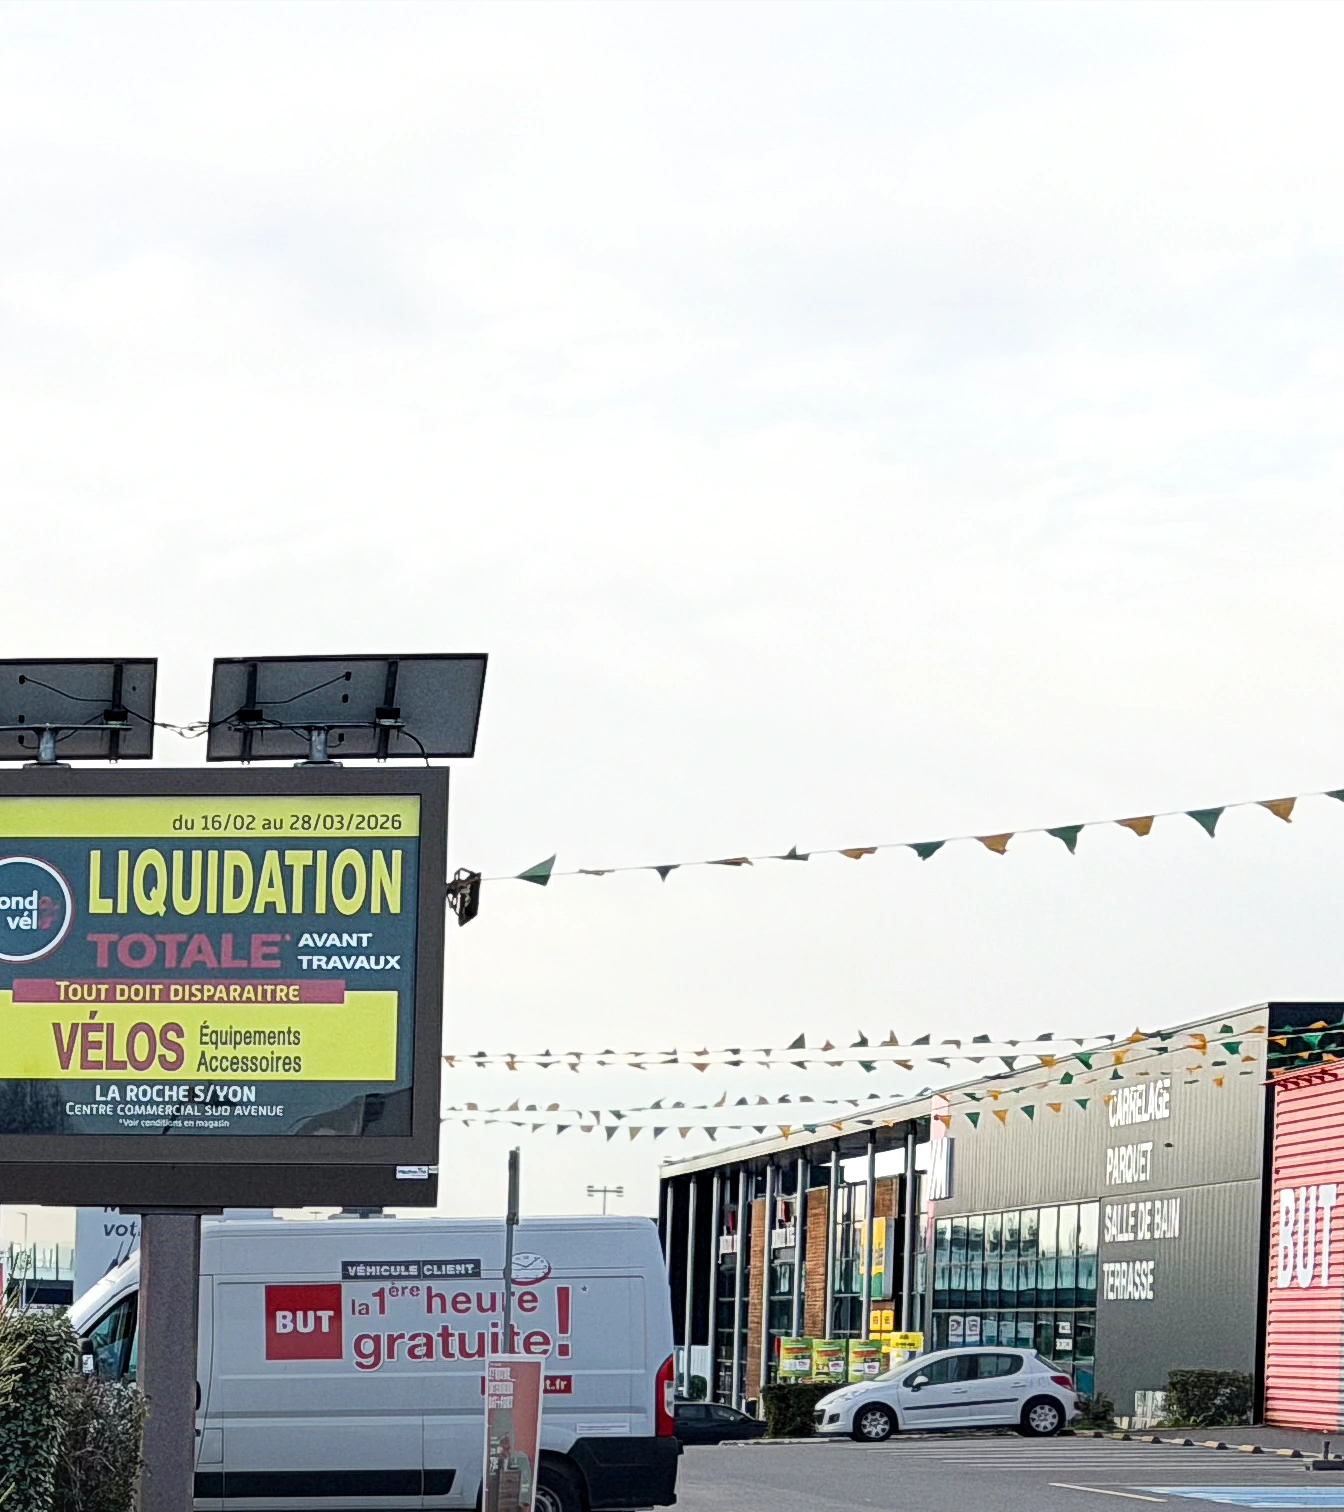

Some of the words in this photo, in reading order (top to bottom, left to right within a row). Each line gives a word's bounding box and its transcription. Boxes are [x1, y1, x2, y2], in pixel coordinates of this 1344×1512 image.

[172, 814, 195, 831] du
[201, 813, 256, 832] 16/02
[261, 817, 284, 831] au
[289, 813, 402, 832] 28/03/2026
[88, 848, 403, 917] LIQUIDATION
[297, 932, 373, 948] AVANT
[297, 955, 401, 970] TRAVAUX
[115, 985, 164, 1001] DOIT
[169, 984, 300, 1002] DISPARAITRE
[51, 1010, 185, 1072] VÉLOS
[199, 1020, 301, 1050] Équipements
[196, 1050, 302, 1073] Accessoires
[95, 1084, 120, 1102] LA
[126, 1084, 190, 1102] ROCHE
[194, 1084, 256, 1102] S/YON
[1108, 1077, 1171, 1128] CARRELAGE
[116, 1103, 201, 1117] COMMERCIAL
[204, 1103, 231, 1117] SUD
[233, 1104, 284, 1117] AVENUE
[1105, 1141, 1153, 1186] PARQUET
[103, 1220, 141, 1237] vot
[1103, 1202, 1136, 1243] SALLE
[1137, 1201, 1152, 1240] DE
[1153, 1198, 1181, 1239] BAIN
[1277, 1184, 1337, 1289] BUT
[346, 1262, 420, 1277] VÉHICULE
[423, 1262, 475, 1276] CLIENT
[1102, 1260, 1155, 1300] TERRASSE
[351, 1298, 370, 1316] la
[371, 1281, 421, 1316] 1ère
[275, 1310, 334, 1334] BUT
